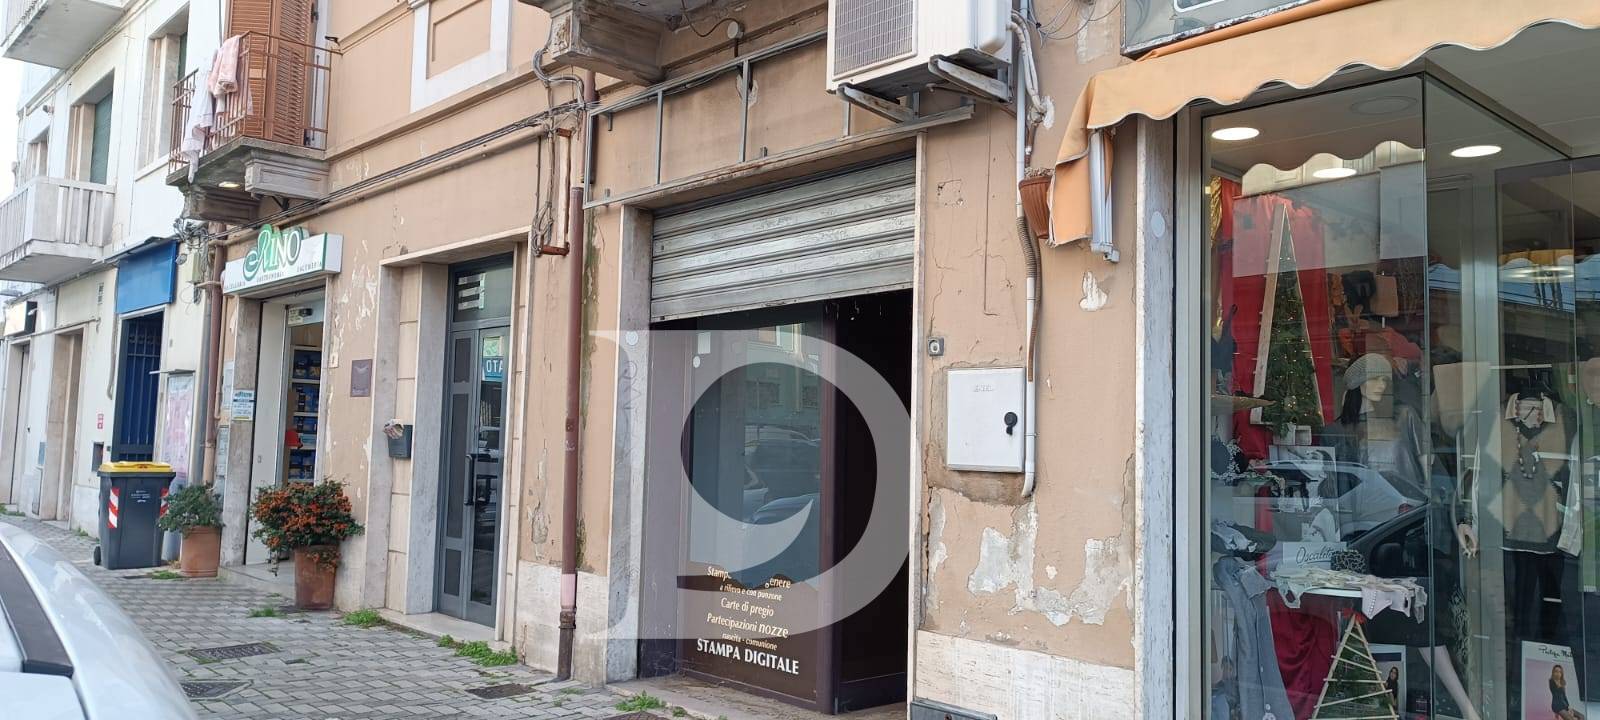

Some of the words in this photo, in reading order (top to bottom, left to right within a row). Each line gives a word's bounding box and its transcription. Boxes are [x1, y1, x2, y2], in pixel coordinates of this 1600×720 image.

[243, 229, 302, 281] RINO
[721, 597, 740, 611] Carte
[742, 601, 749, 612] di
[749, 605, 774, 618] pregio
[706, 612, 757, 632] Partecipazioni
[758, 623, 789, 639] nozze
[697, 638, 741, 660] STAMPA
[744, 648, 799, 675] DIGITALE
